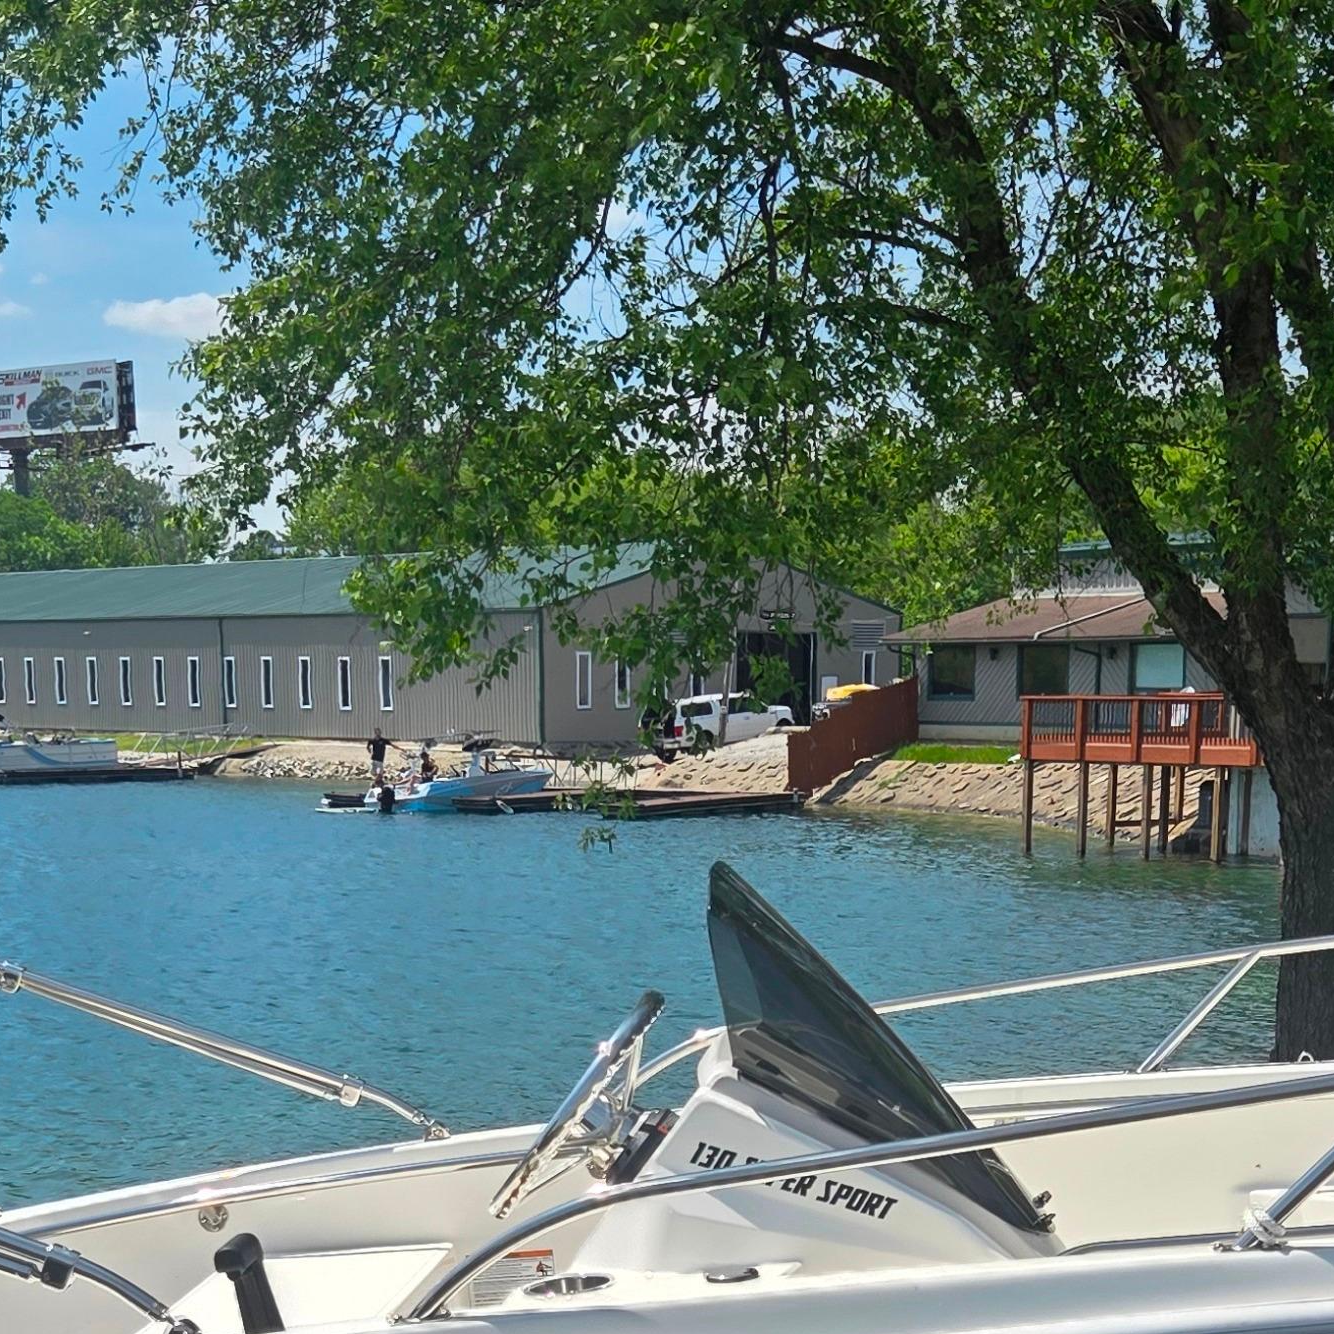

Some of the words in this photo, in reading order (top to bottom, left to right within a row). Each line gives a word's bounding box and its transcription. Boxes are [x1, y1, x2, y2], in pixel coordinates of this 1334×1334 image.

[86, 366, 112, 375] GMC
[689, 1142, 737, 1170] 130
[816, 1179, 899, 1220] SPORT
